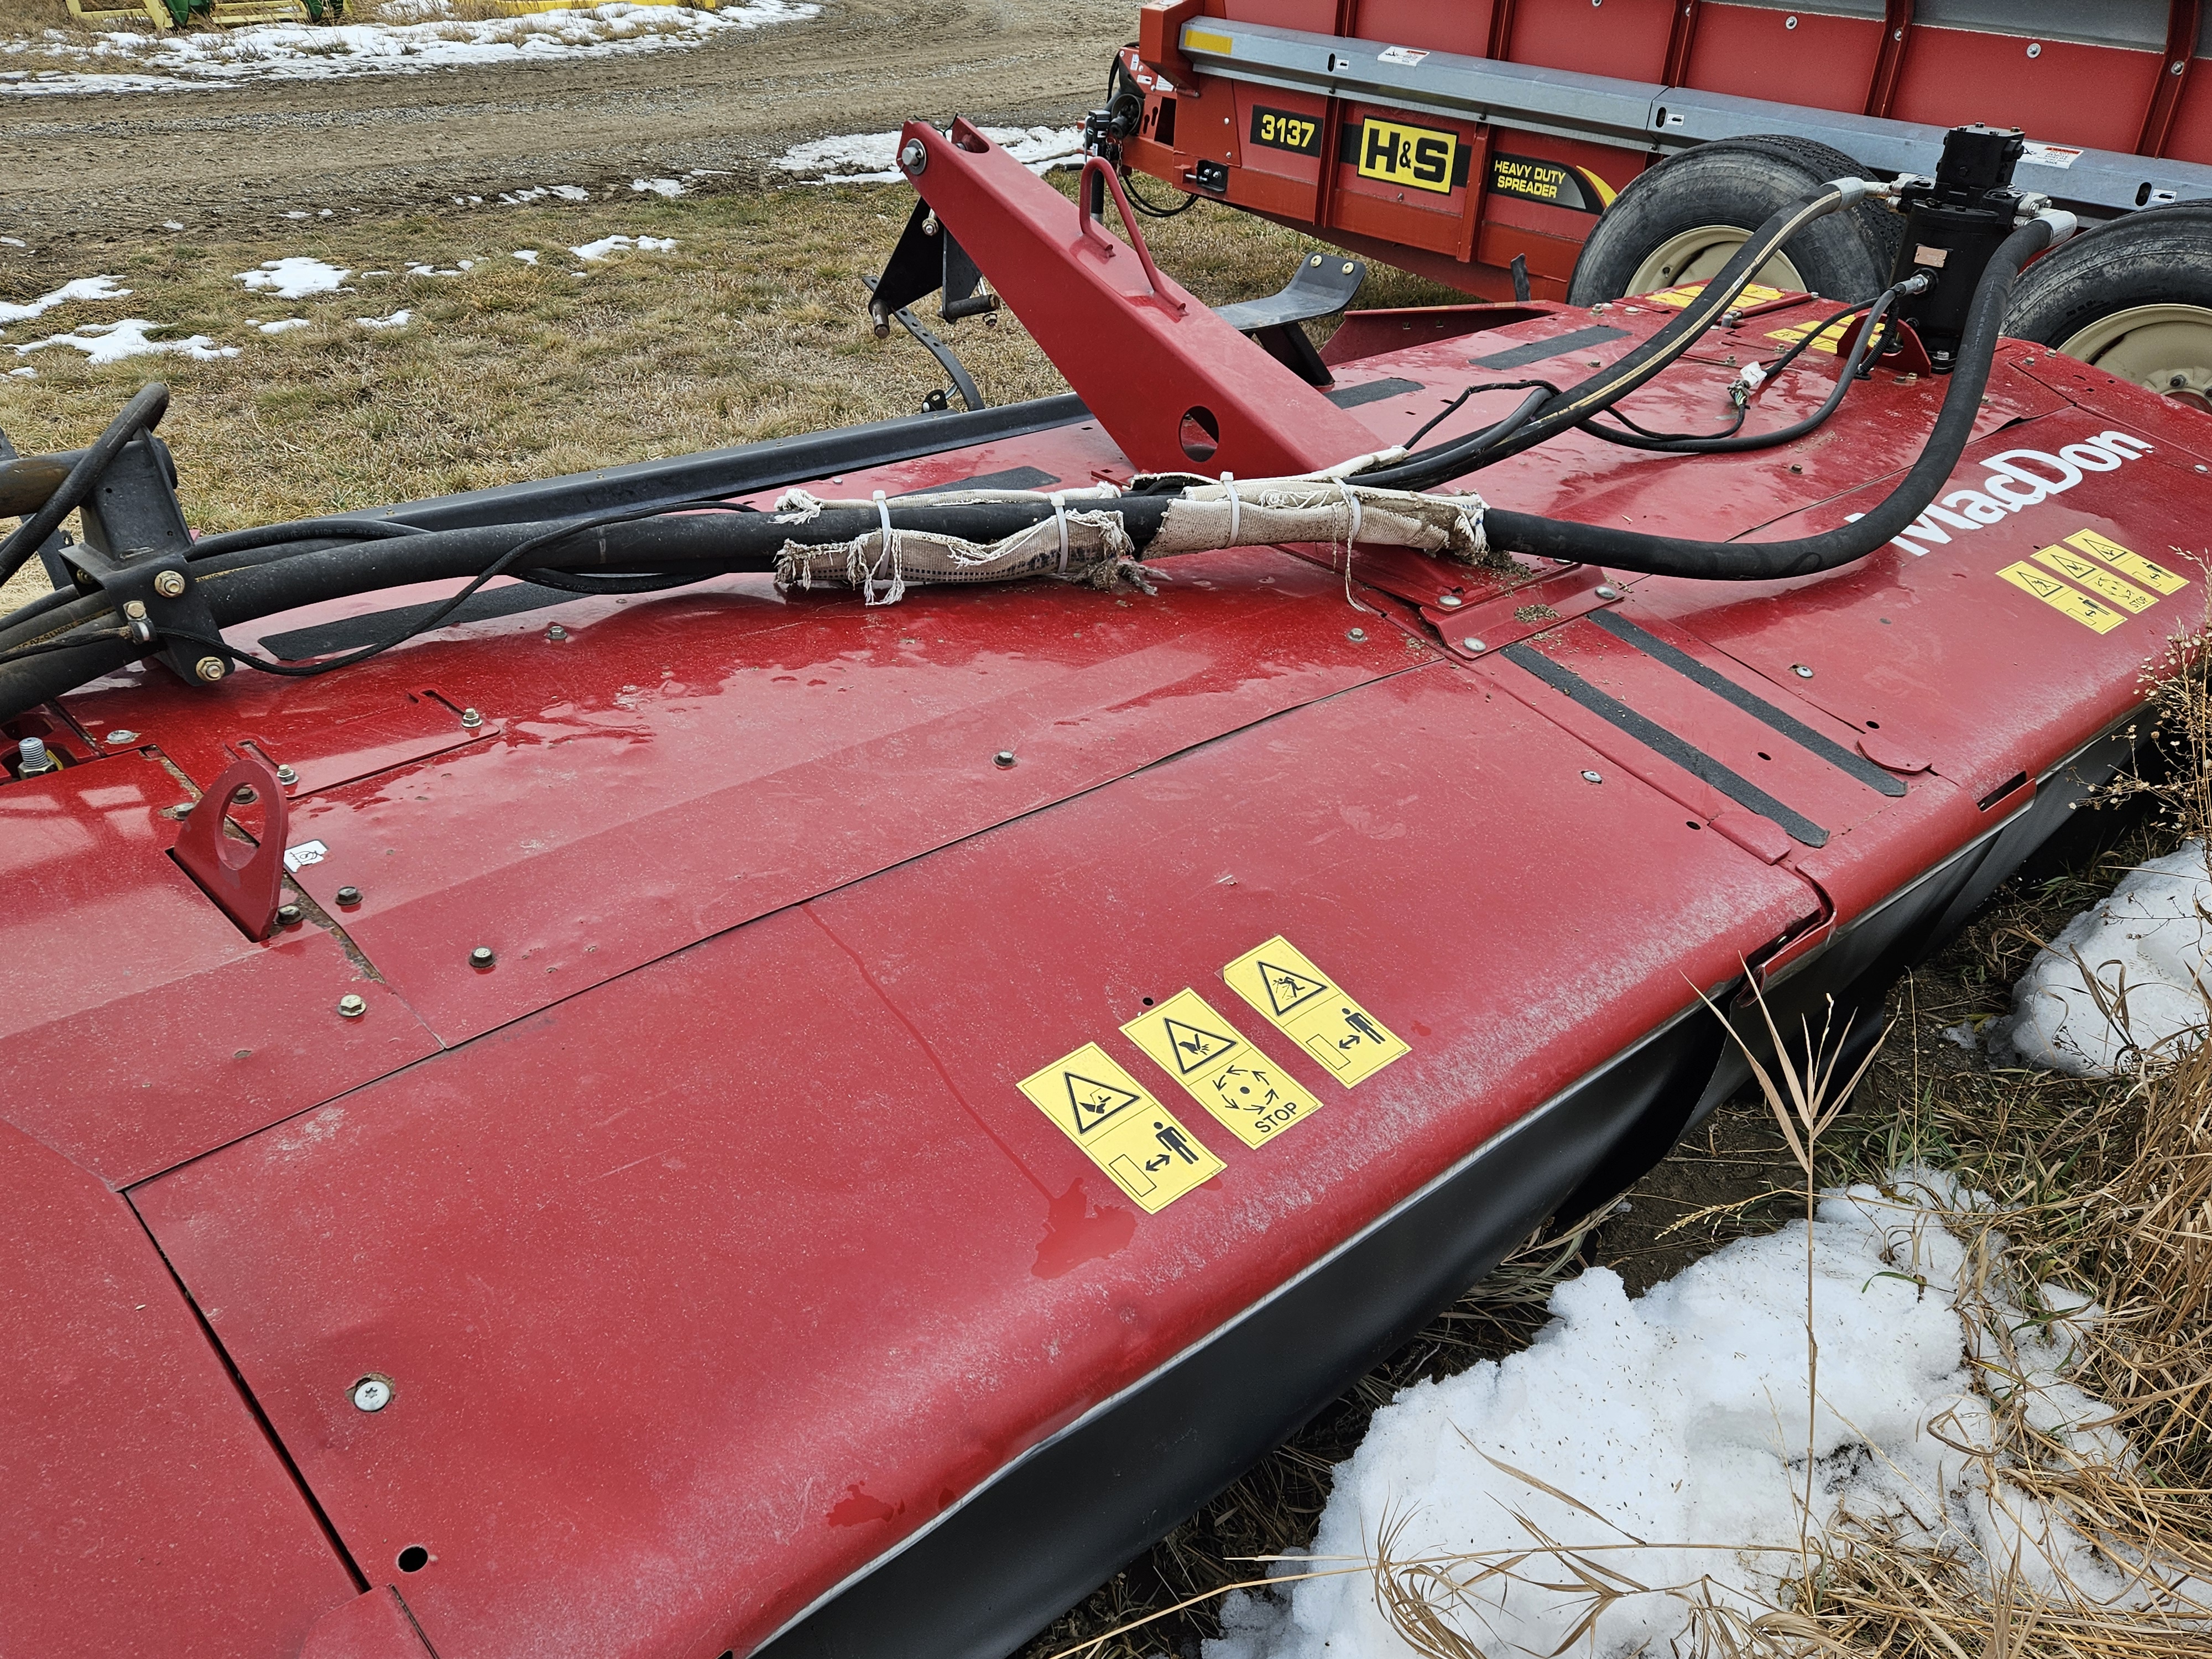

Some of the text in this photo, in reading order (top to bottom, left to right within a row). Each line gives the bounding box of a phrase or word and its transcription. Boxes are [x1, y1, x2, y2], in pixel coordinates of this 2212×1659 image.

[1261, 114, 1315, 148] 3137
[1365, 127, 1449, 183] H&S
[1494, 160, 1566, 185] HEAVY DUTY
[1497, 175, 1557, 199] SPREADER
[2129, 596, 2148, 608] STOP
[1255, 1102, 1297, 1133] STOP
